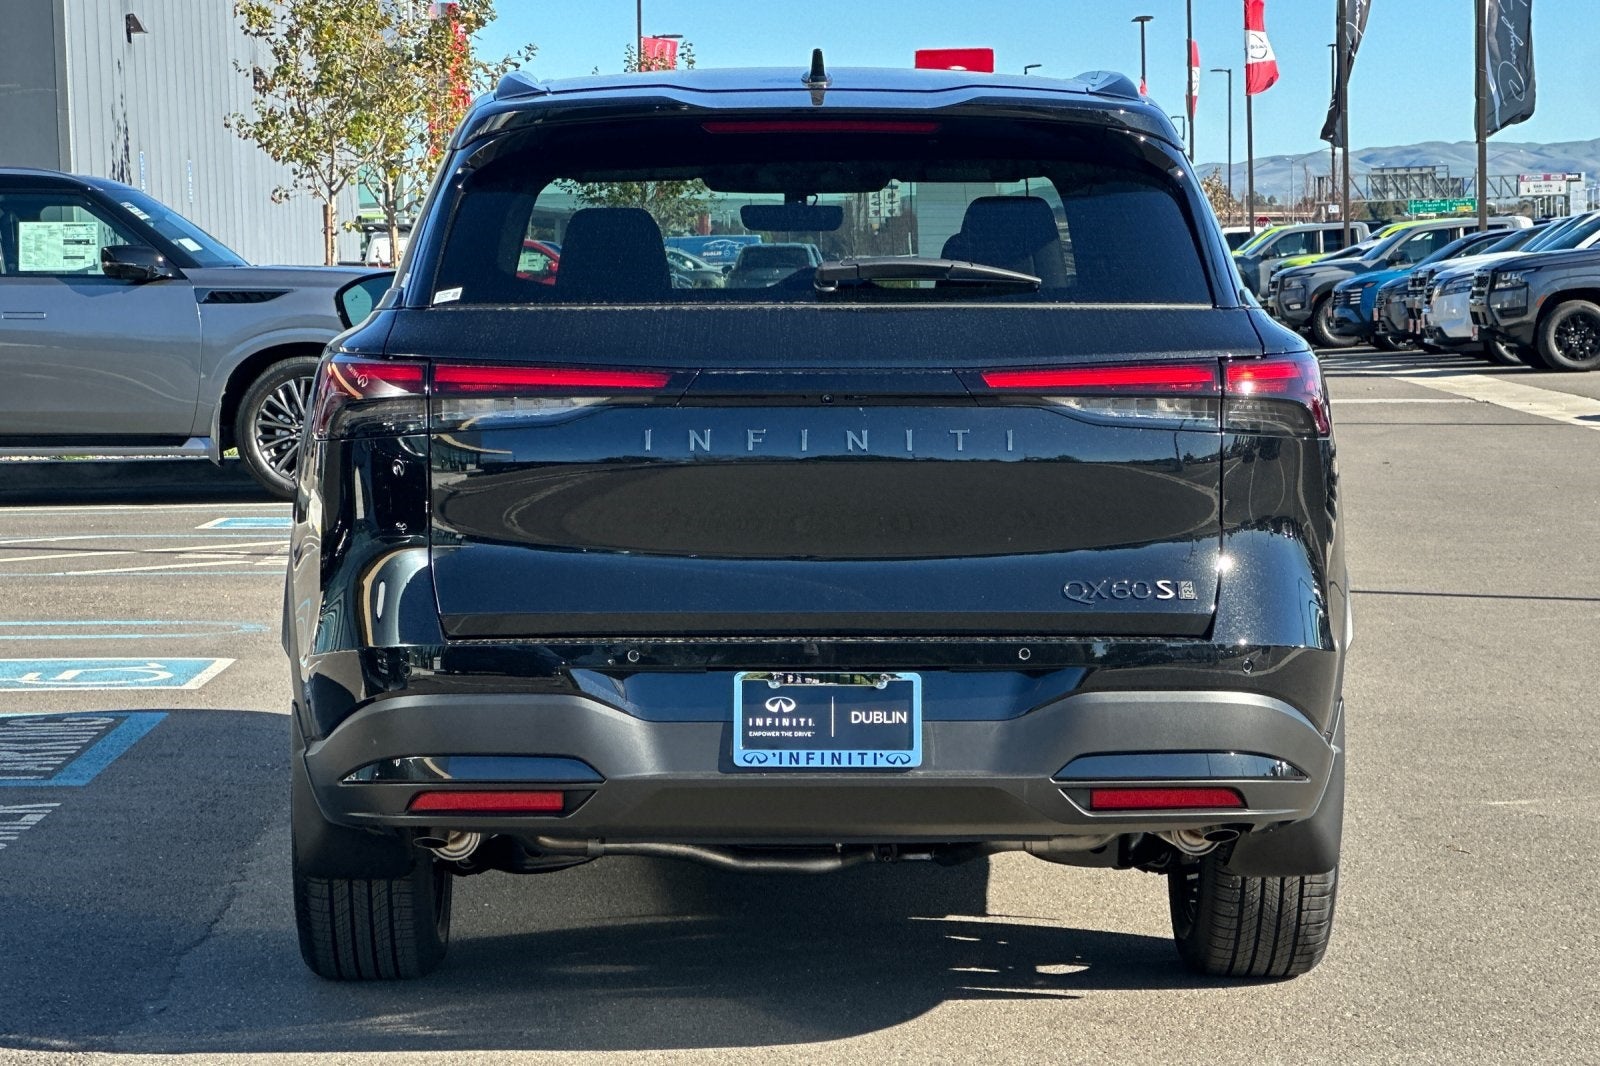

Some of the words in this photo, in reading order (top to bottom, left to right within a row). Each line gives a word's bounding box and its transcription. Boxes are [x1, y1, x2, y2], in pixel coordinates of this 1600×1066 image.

[644, 428, 1013, 452] INFINITI
[1063, 580, 1151, 604] QX60
[851, 710, 908, 724] DUBLIN
